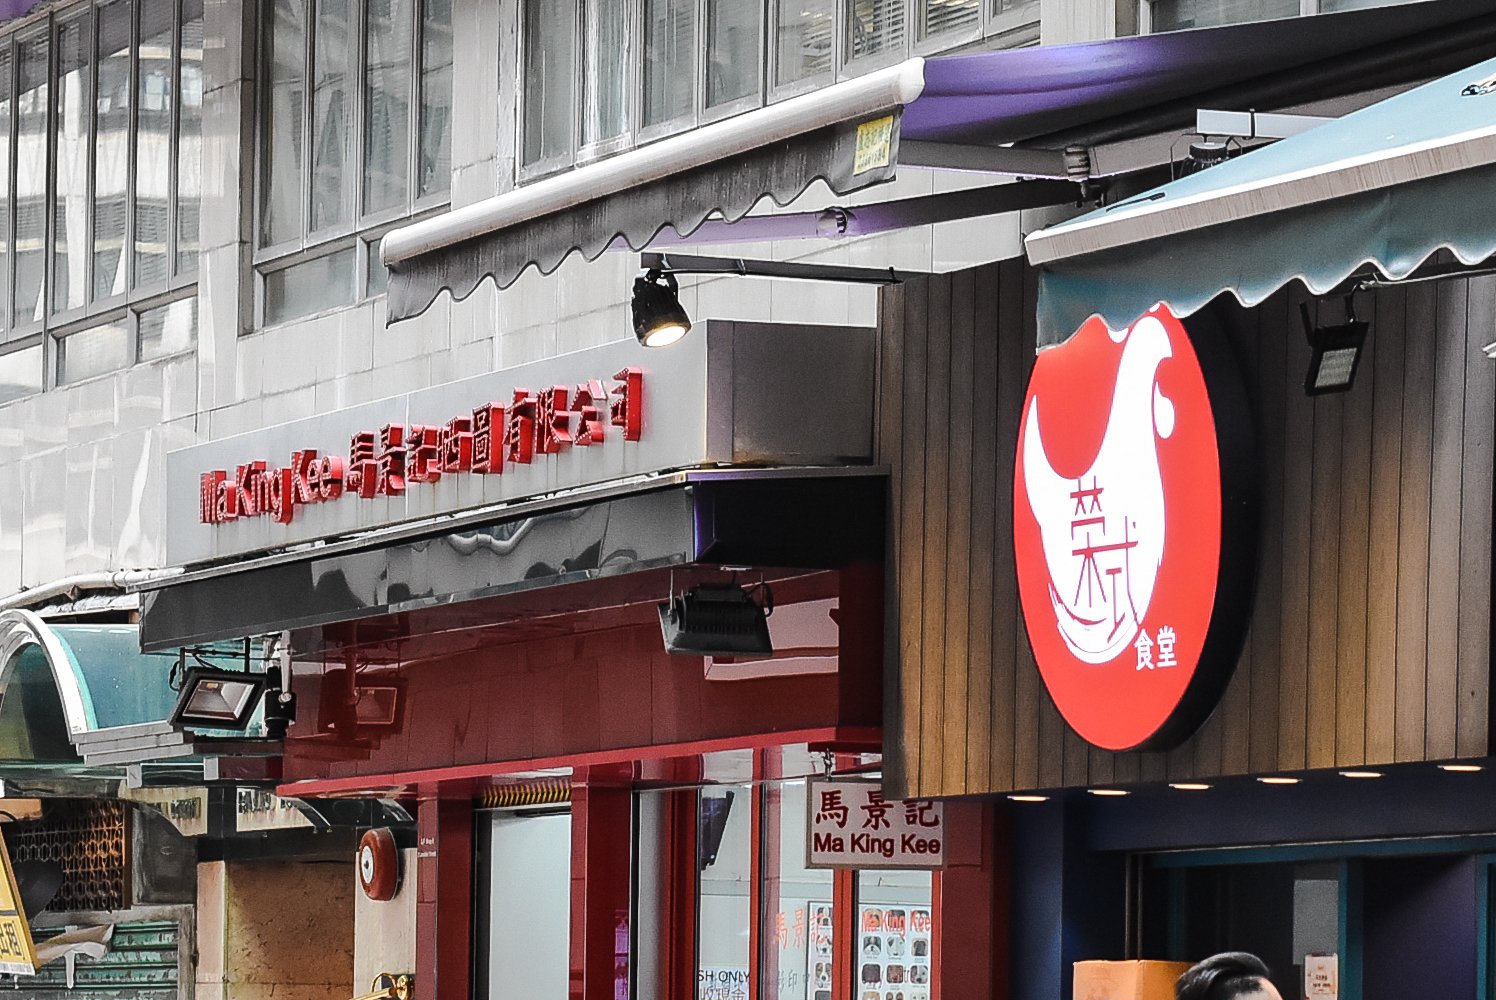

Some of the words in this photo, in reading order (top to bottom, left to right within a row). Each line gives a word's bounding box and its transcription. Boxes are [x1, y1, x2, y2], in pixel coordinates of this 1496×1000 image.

[201, 471, 238, 523] Ma
[236, 460, 293, 524] King
[291, 448, 343, 504] Kee
[1134, 626, 1178, 670] 食堂
[815, 790, 940, 830] 馬景記
[814, 833, 844, 852] Ma
[850, 833, 894, 858] King
[901, 833, 940, 854] Kee
[718, 970, 749, 983] ONLY
